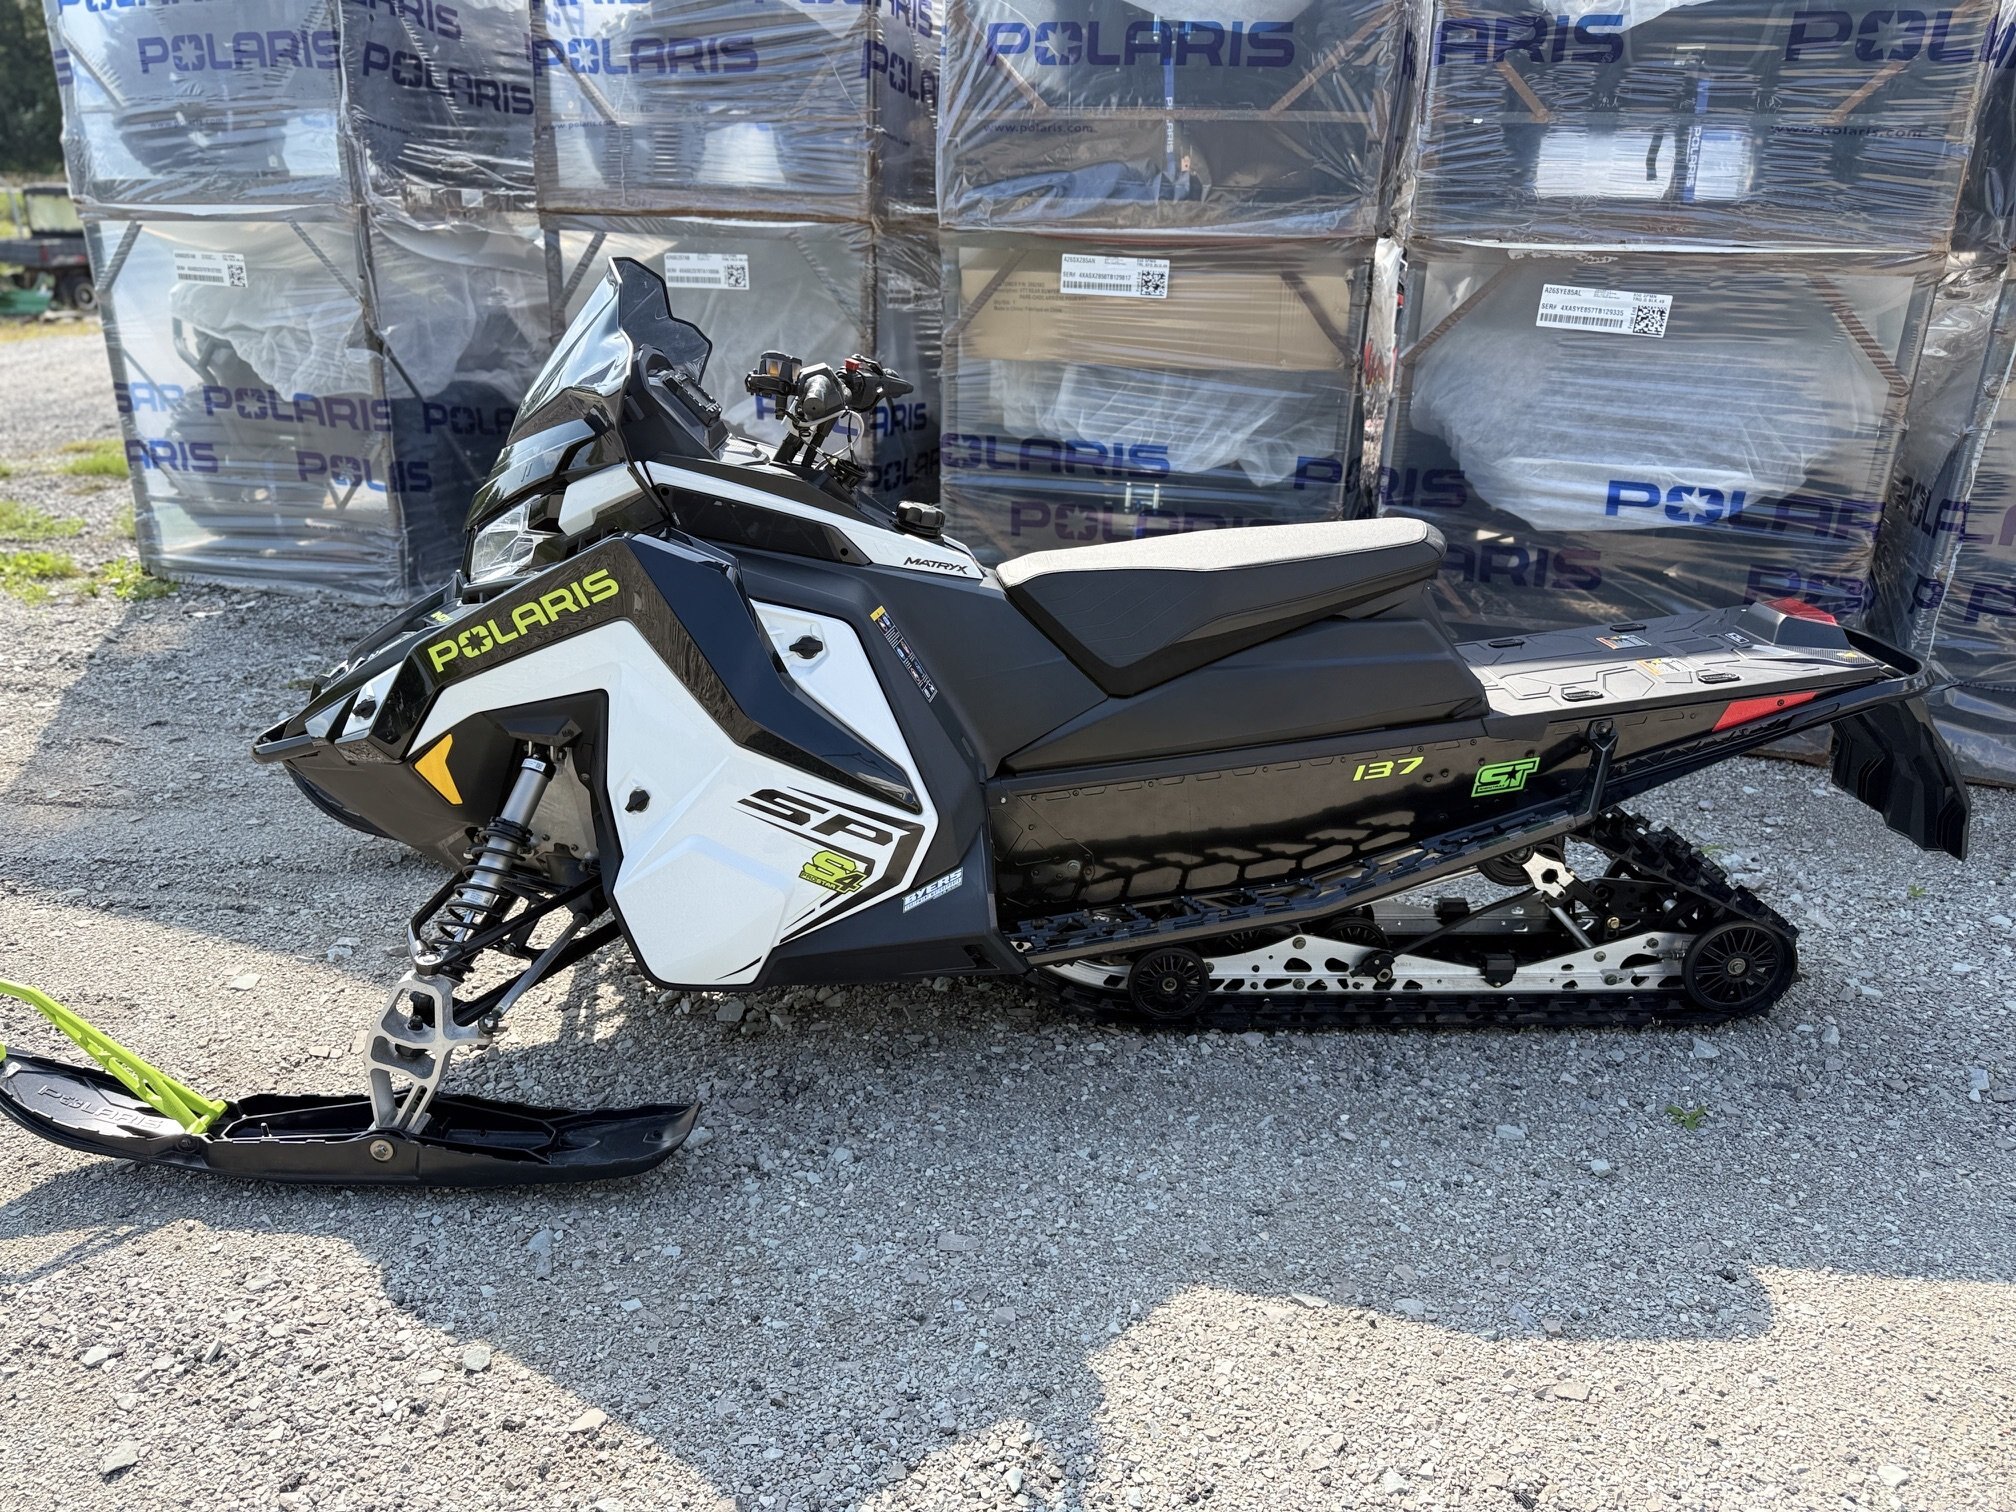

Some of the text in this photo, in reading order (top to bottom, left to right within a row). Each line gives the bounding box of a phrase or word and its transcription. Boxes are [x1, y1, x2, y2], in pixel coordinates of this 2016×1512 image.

[138, 31, 341, 75] POLARIS
[531, 37, 759, 77] POLARIS
[985, 21, 1296, 68] POLARIS
[362, 41, 534, 115] POLARIS
[983, 123, 1094, 134] www.polaris.com
[1686, 127, 1702, 187] POLARIS
[202, 385, 391, 432] POLARIS
[904, 557, 968, 575] MATRYX
[427, 568, 619, 673] POLARIS
[1353, 756, 1424, 782] 137
[737, 788, 893, 847] SP
[800, 872, 837, 889] PROSTAR
[904, 869, 963, 904] BYERS
[38, 1085, 163, 1129] POLARIS
